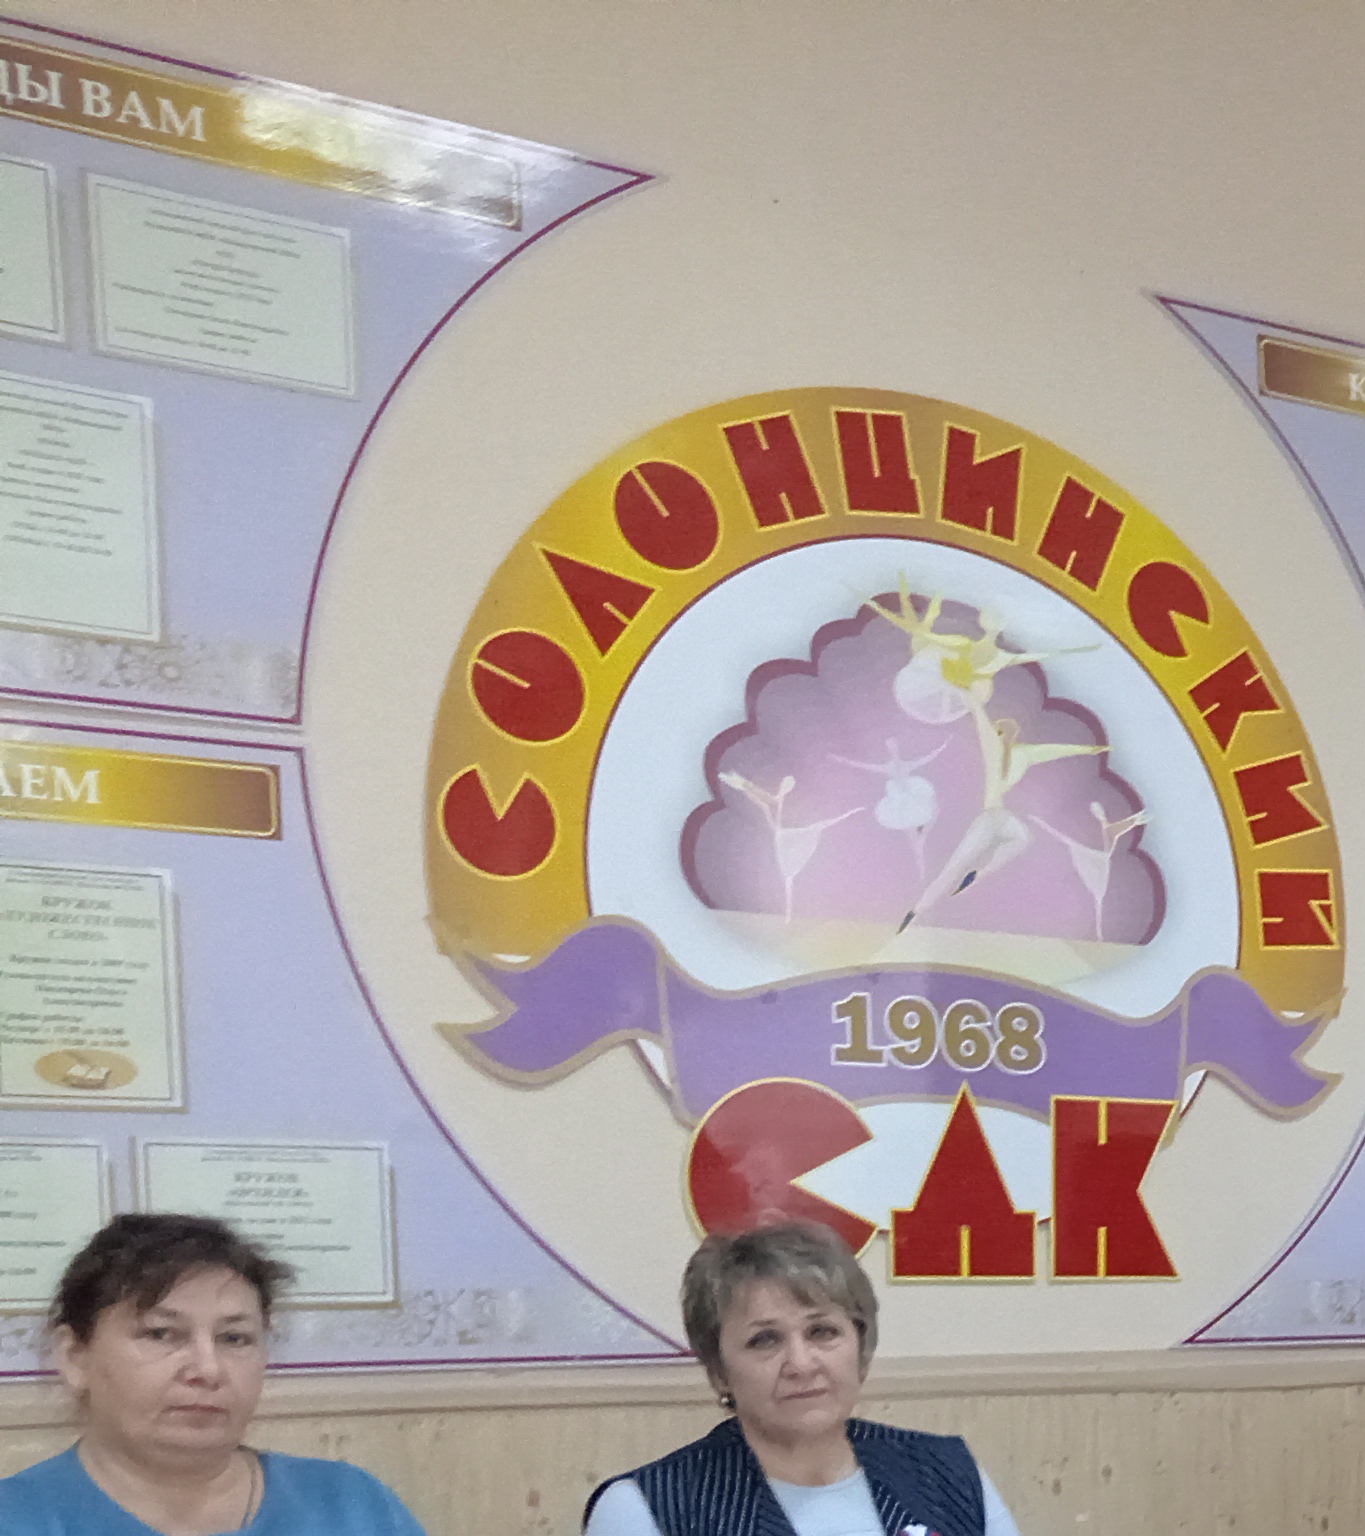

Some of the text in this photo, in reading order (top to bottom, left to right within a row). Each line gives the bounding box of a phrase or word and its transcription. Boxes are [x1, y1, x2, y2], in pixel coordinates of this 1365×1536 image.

[78, 78, 207, 142] ВАМ
[438, 407, 1340, 950] СОЛОНЦИНСКИЙ
[830, 991, 1049, 1076] 1968
[686, 1076, 1181, 1284] СДК
